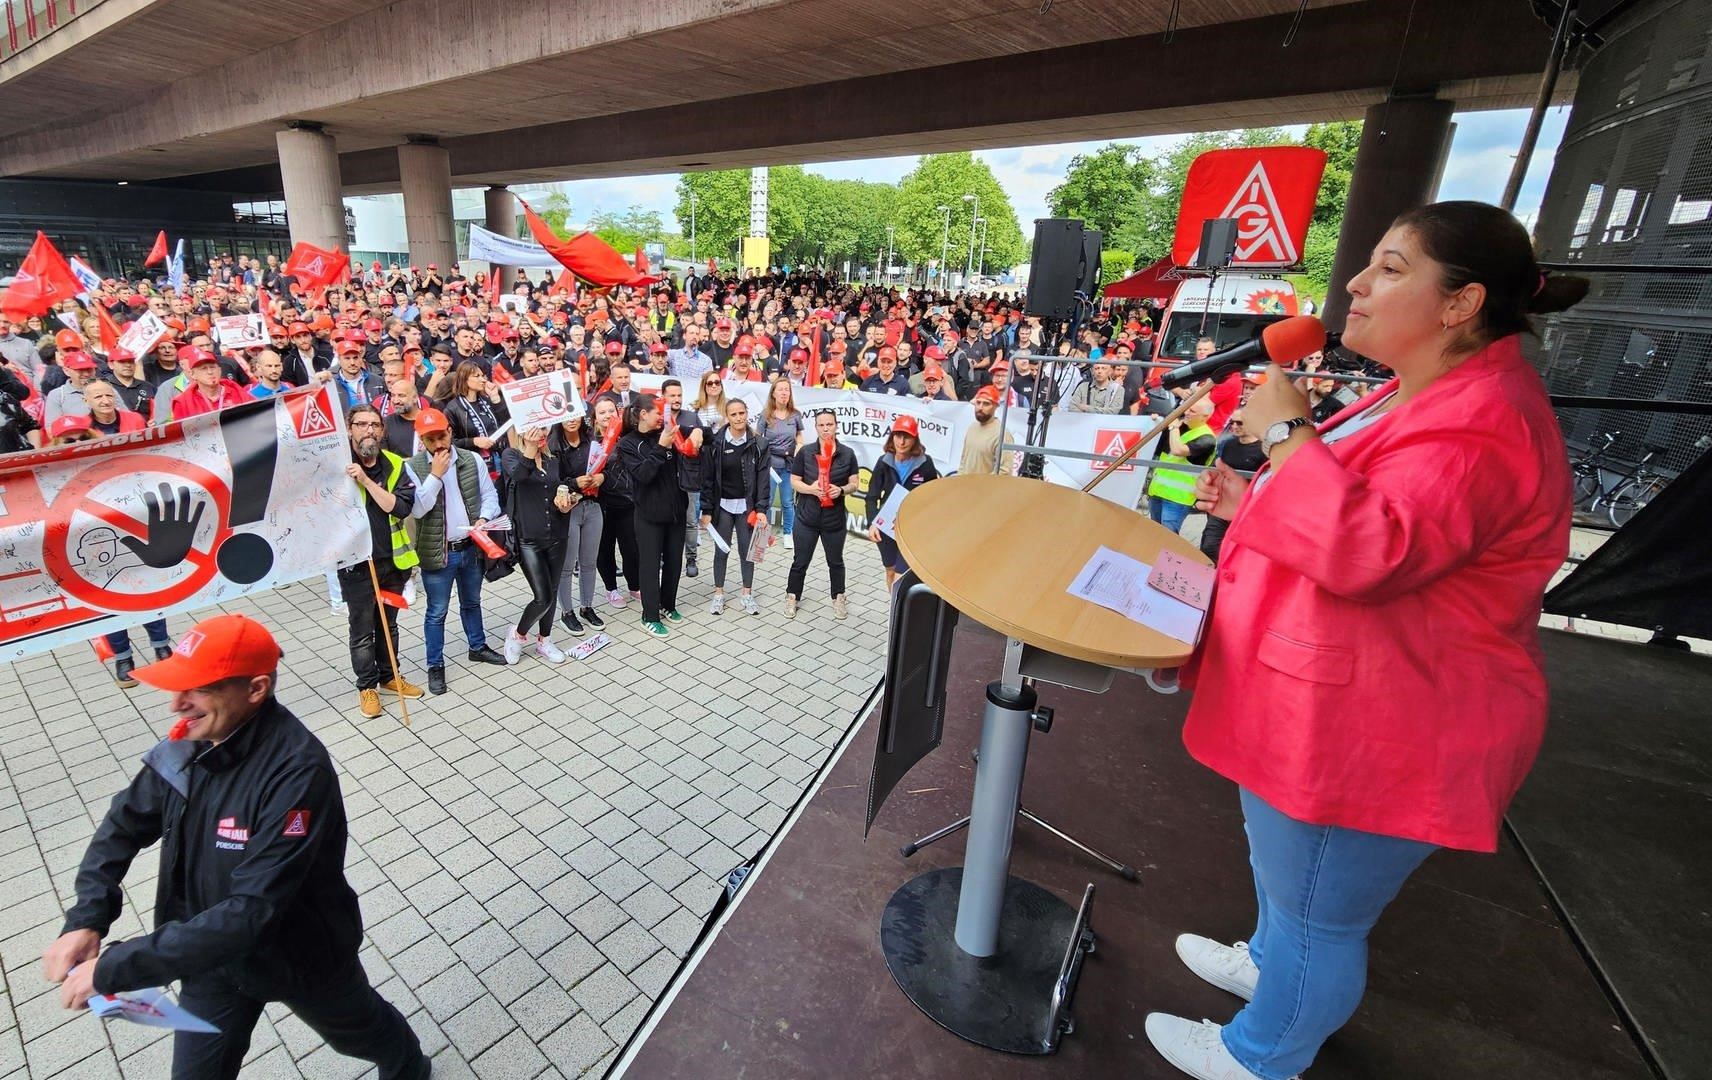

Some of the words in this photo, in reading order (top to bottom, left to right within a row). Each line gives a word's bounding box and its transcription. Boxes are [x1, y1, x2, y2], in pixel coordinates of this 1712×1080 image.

[864, 407, 887, 420] EIN
[891, 412, 949, 436] SDORT
[215, 840, 246, 850] PORSCHE
